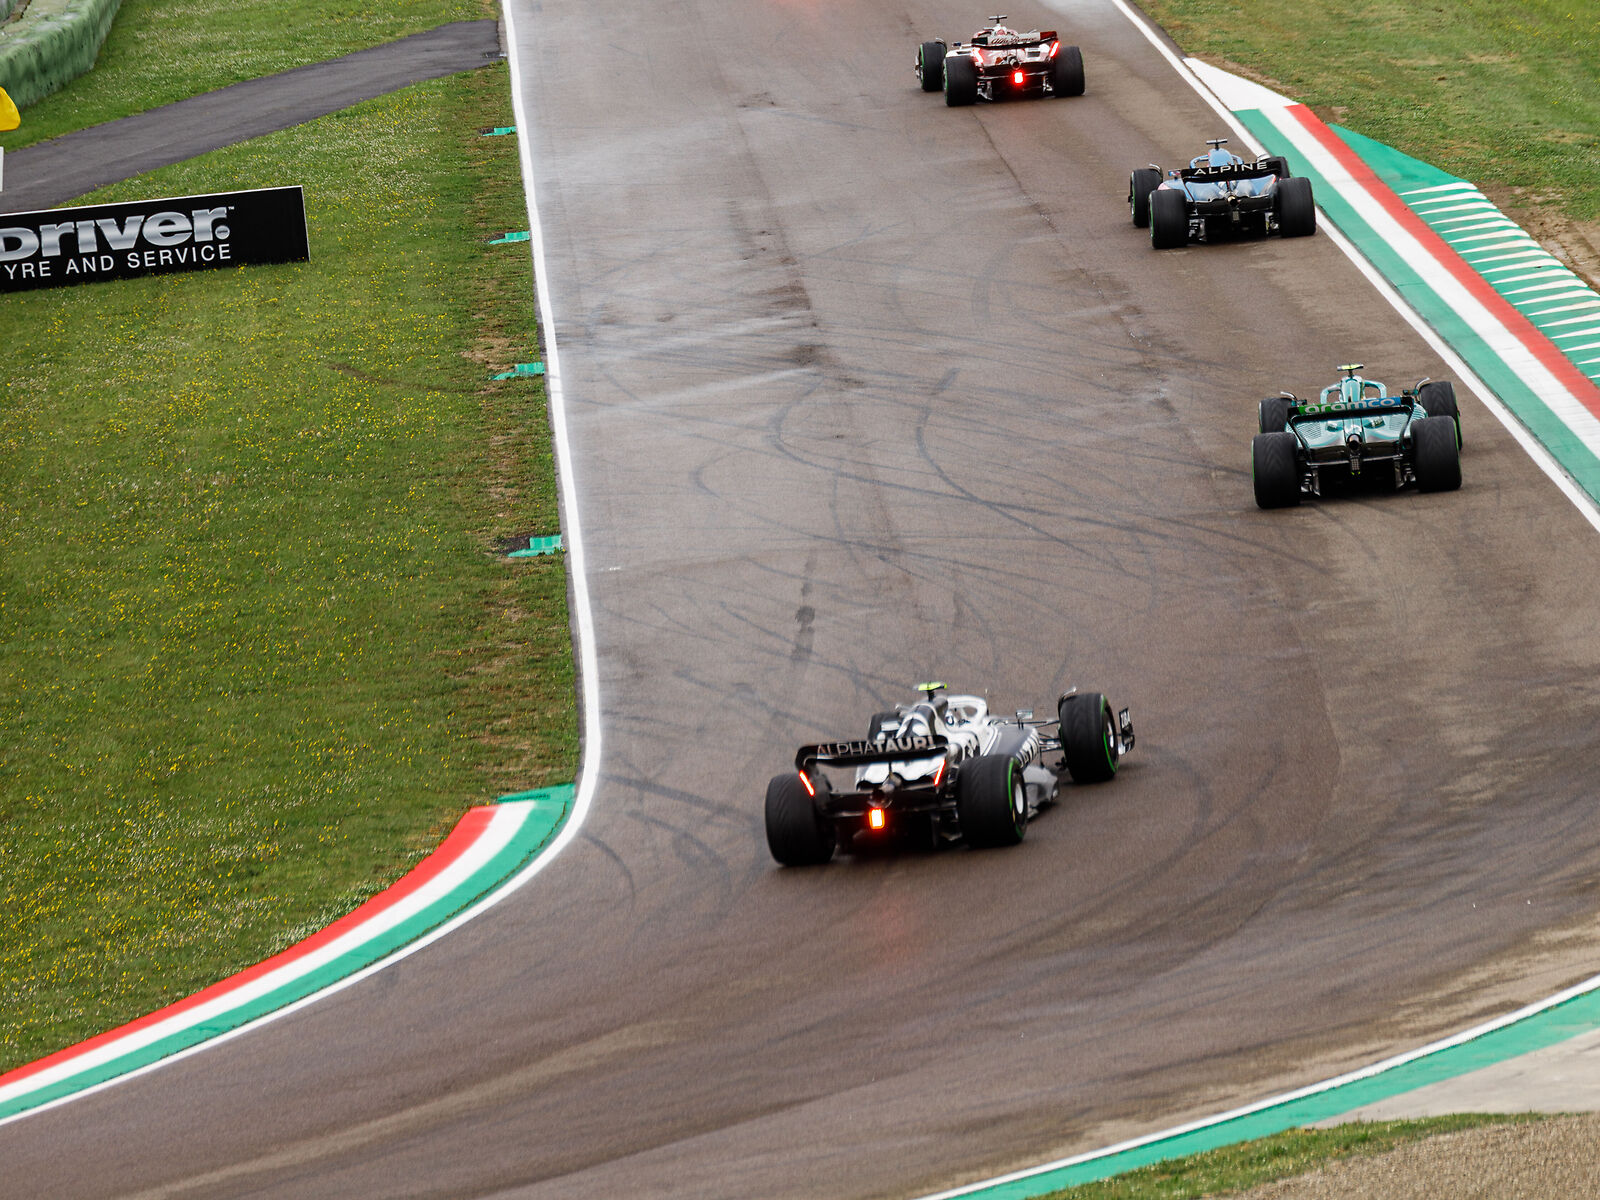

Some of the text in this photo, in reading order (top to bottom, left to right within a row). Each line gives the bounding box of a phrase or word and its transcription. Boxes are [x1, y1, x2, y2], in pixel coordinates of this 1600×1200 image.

[1194, 161, 1268, 176] ALPINE
[0, 243, 232, 281] YRE AND SERVICE
[1304, 398, 1396, 414] aramco
[816, 735, 935, 757] ALPHATAURI
